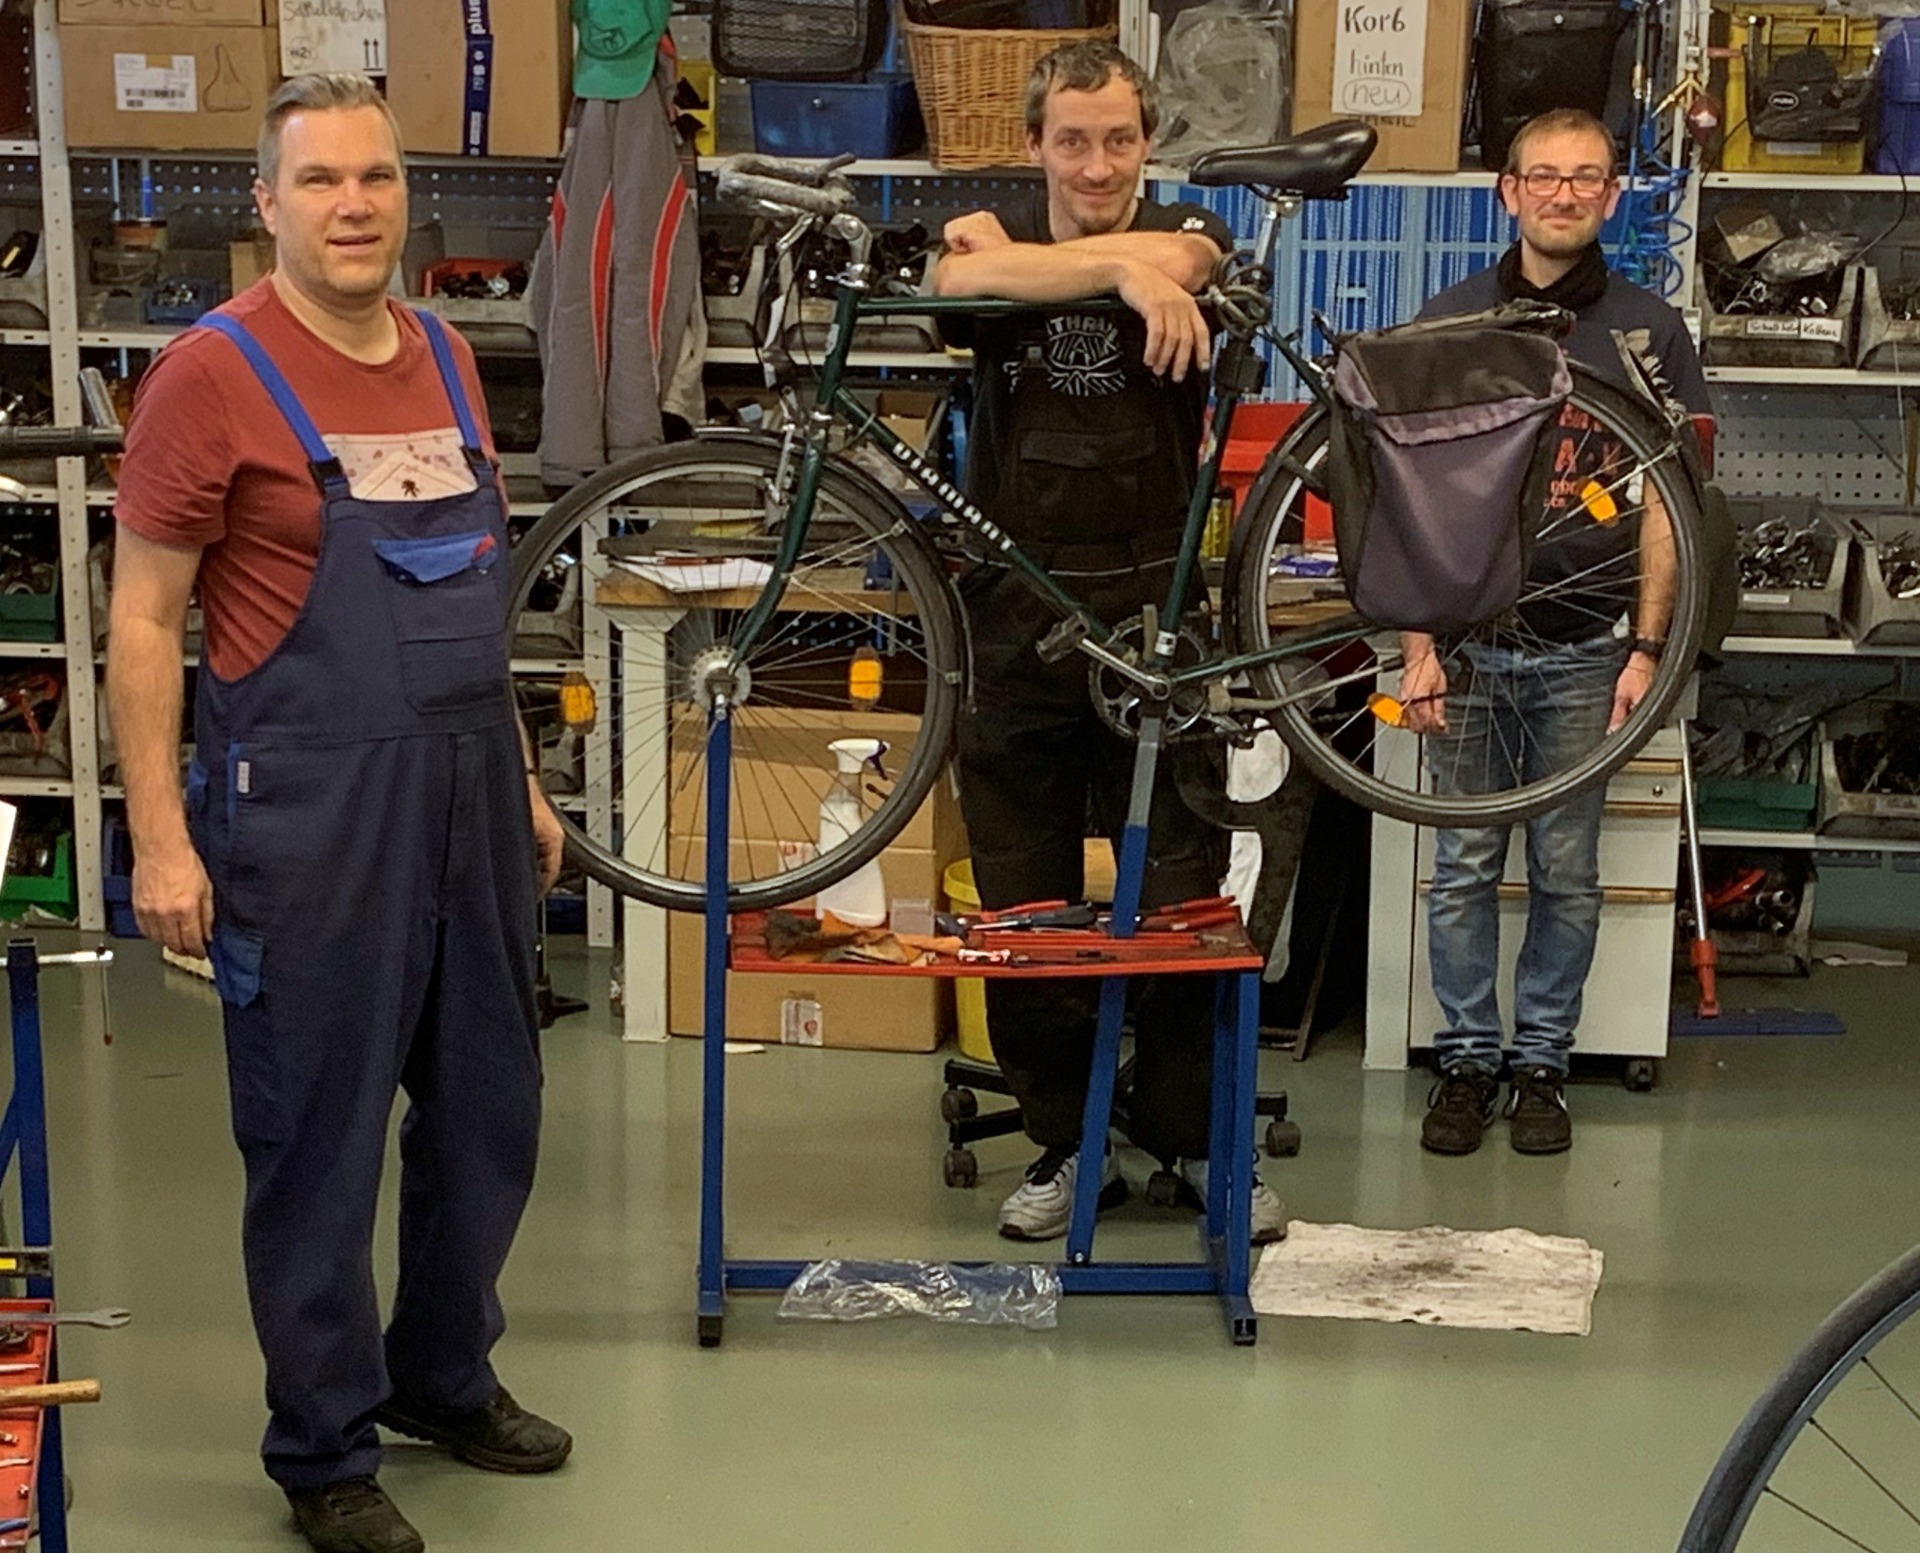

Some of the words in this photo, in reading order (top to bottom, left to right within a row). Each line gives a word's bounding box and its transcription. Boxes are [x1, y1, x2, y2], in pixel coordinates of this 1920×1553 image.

[1344, 5, 1406, 34] Korb
[1350, 48, 1403, 77] hinten
[1352, 82, 1401, 107] neu
[892, 441, 1016, 551] DIAMANT
